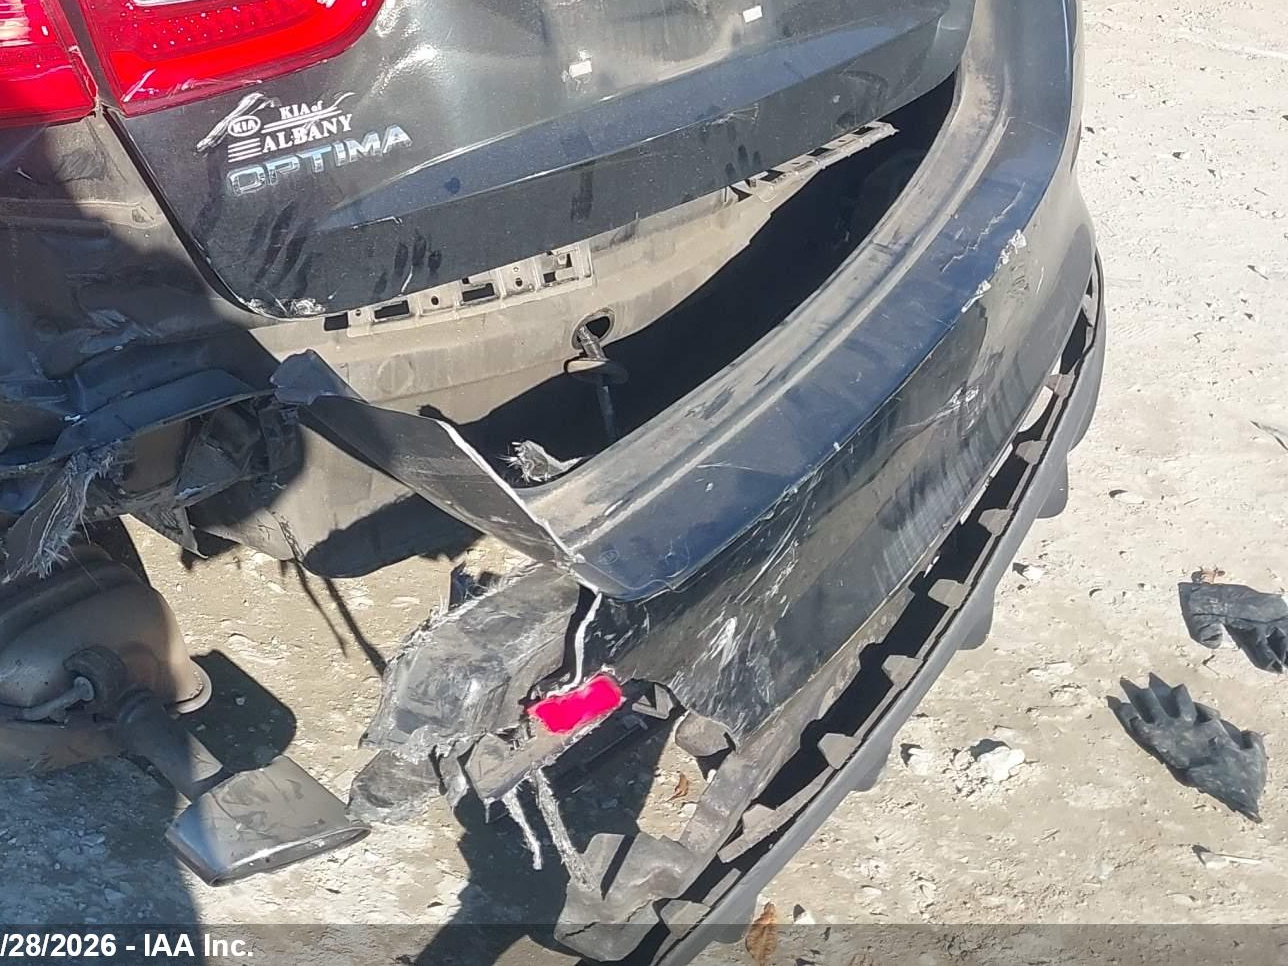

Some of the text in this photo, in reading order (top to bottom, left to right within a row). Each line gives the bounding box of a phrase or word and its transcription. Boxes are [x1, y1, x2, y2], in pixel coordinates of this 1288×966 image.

[279, 100, 324, 120] KIA of
[231, 119, 257, 134] KIA
[262, 114, 352, 153] ALBANY
[226, 124, 413, 196] OPTIMA
